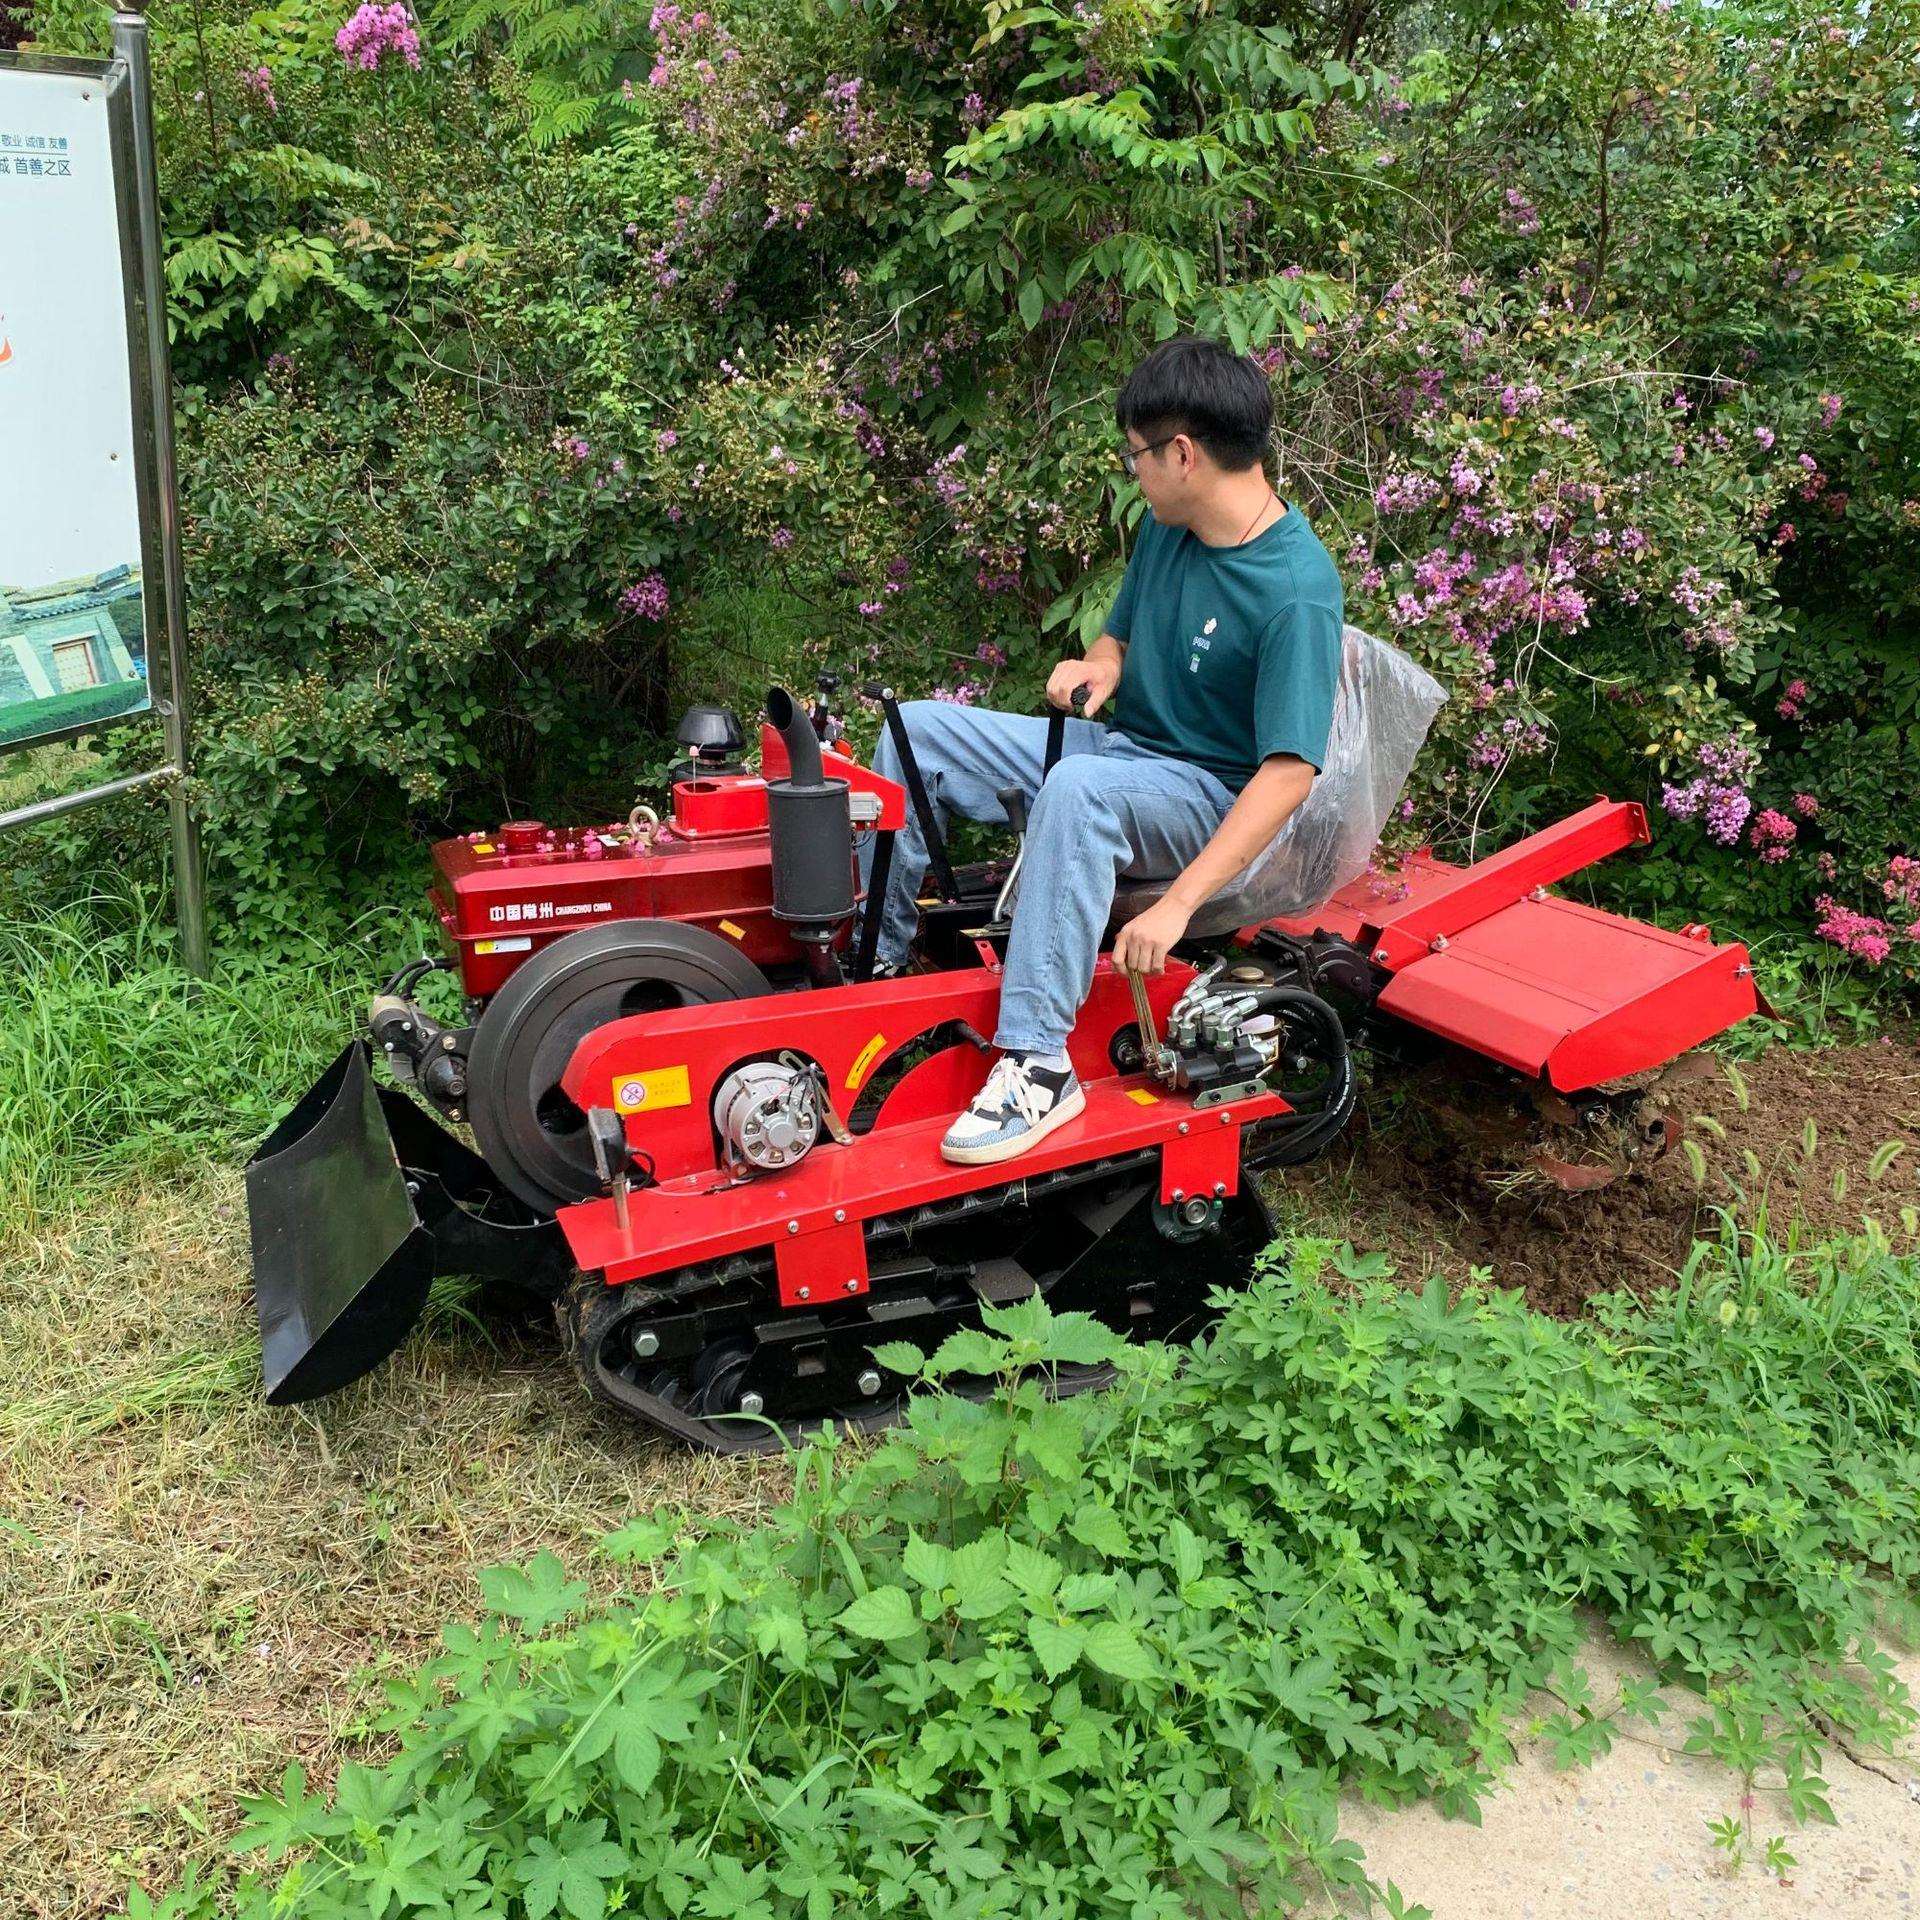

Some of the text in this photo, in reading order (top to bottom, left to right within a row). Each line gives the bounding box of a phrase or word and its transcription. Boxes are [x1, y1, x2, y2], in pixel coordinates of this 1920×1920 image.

[1, 134, 68, 150] 敬业 诚信 友善
[14, 157, 72, 176] 首善之区
[489, 902, 554, 921] 中国常州
[555, 902, 612, 916] CHANGZHOU CHINA
